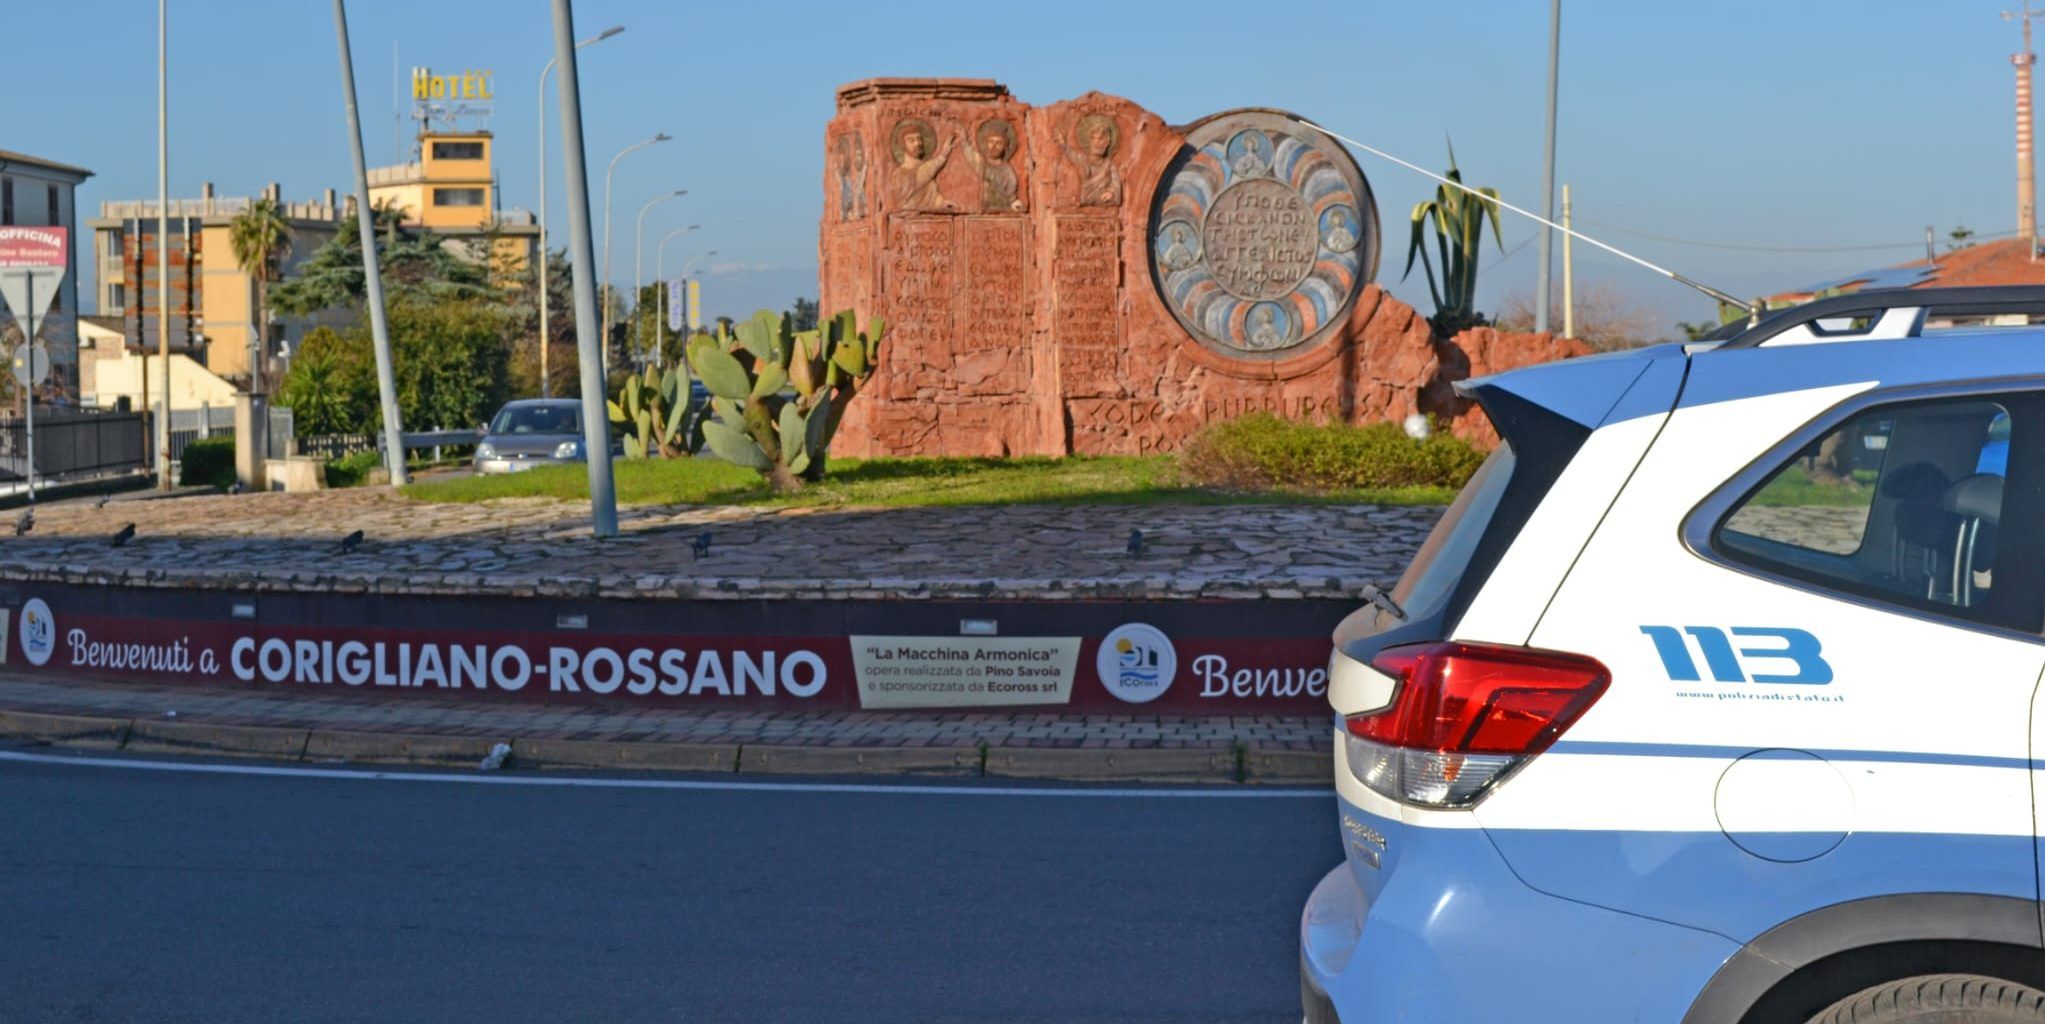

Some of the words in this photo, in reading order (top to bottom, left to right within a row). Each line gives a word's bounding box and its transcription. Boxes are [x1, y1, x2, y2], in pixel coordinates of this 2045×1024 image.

[412, 74, 493, 101] HOTEL
[0, 229, 61, 248] OFFICINA
[67, 627, 194, 674] Benvenuti
[200, 647, 220, 675] a
[231, 636, 827, 698] CORIGLIANO-ROSSANO
[897, 646, 969, 661] Macchina
[1639, 625, 1834, 685] 113
[865, 666, 900, 677] opera
[904, 665, 963, 677] realizzata
[966, 666, 982, 677] da
[985, 665, 1014, 677] Pino
[1017, 665, 1061, 677] Savoia
[868, 682, 877, 691] e
[879, 682, 965, 694] sponsorizzata
[968, 681, 984, 692] da
[987, 681, 1039, 693] Ecoross
[1042, 681, 1058, 692] srl
